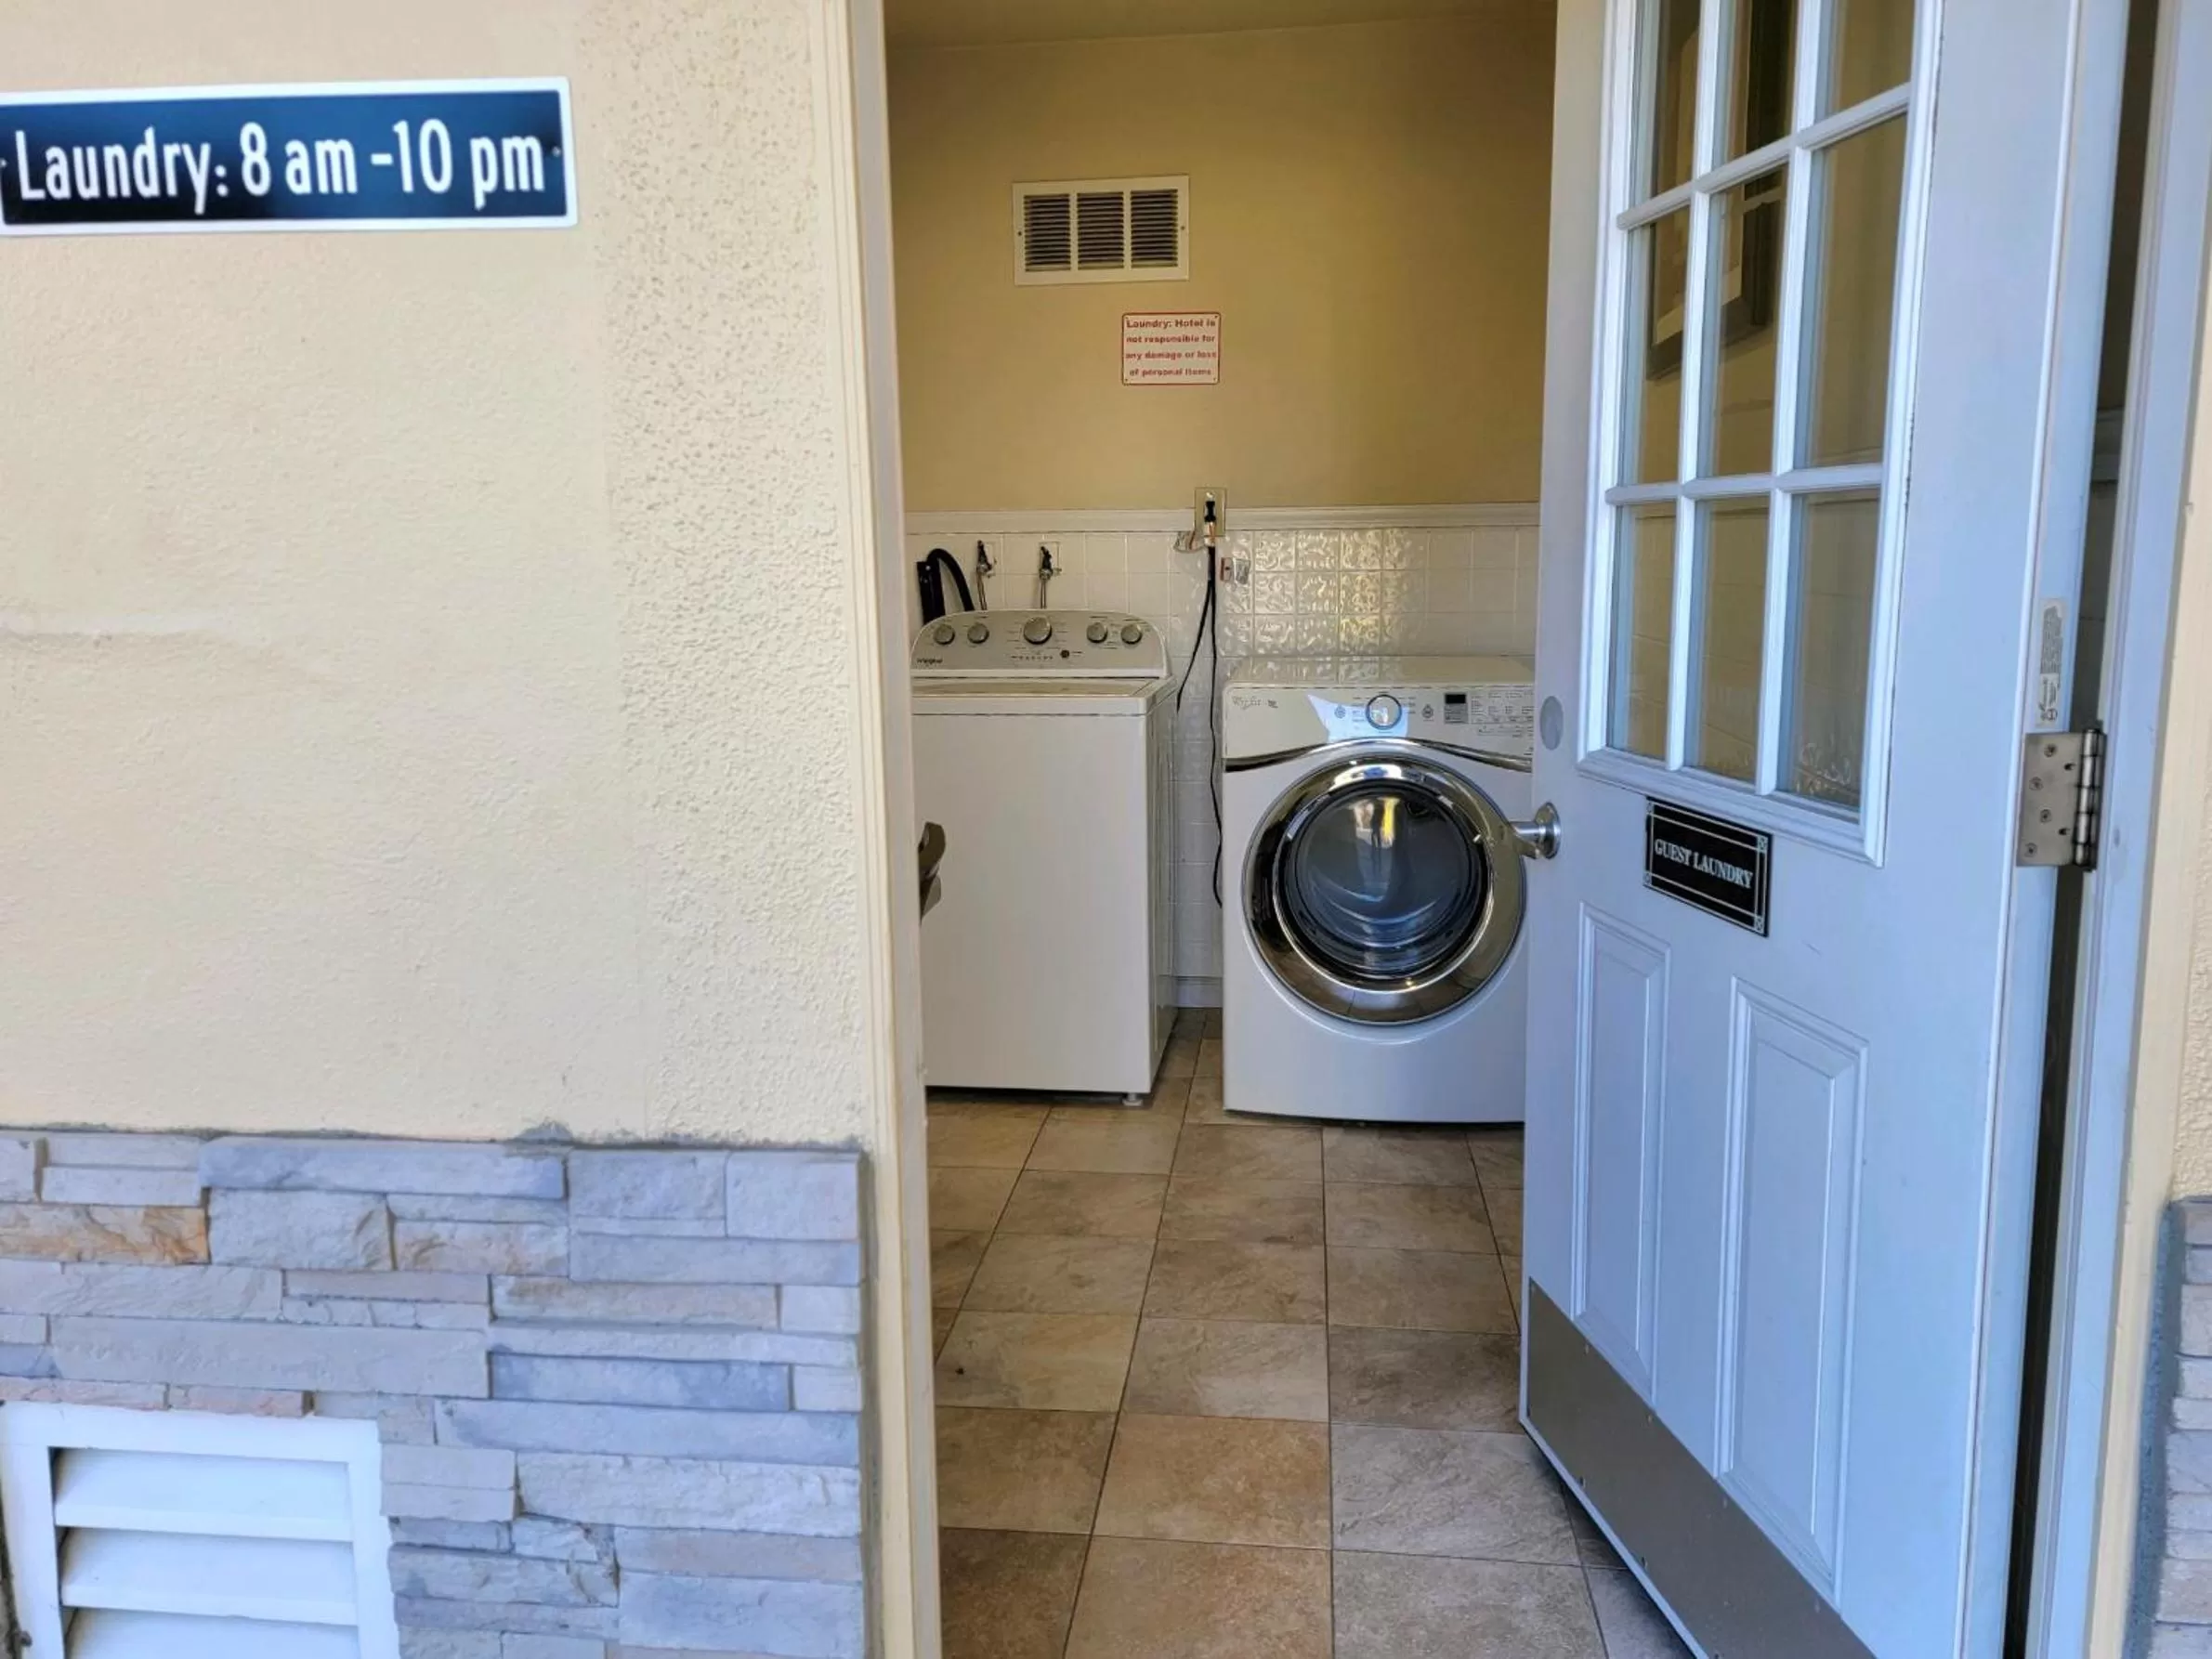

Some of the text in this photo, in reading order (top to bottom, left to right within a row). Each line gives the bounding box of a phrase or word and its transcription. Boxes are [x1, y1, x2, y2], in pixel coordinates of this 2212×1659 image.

[14, 125, 228, 215] Laundry:
[240, 122, 271, 197] 8
[284, 137, 358, 195] am
[469, 132, 544, 211] pm
[1126, 319, 1216, 330] Laundry: Hotel is
[1145, 334, 1199, 345] responsible
[1202, 334, 1215, 343] for
[1125, 352, 1143, 360] any
[1145, 350, 1183, 360] damage
[1129, 368, 1140, 376] of
[1142, 368, 1183, 378] personal
[1655, 838, 1753, 889] GUEST LAUNDRY
